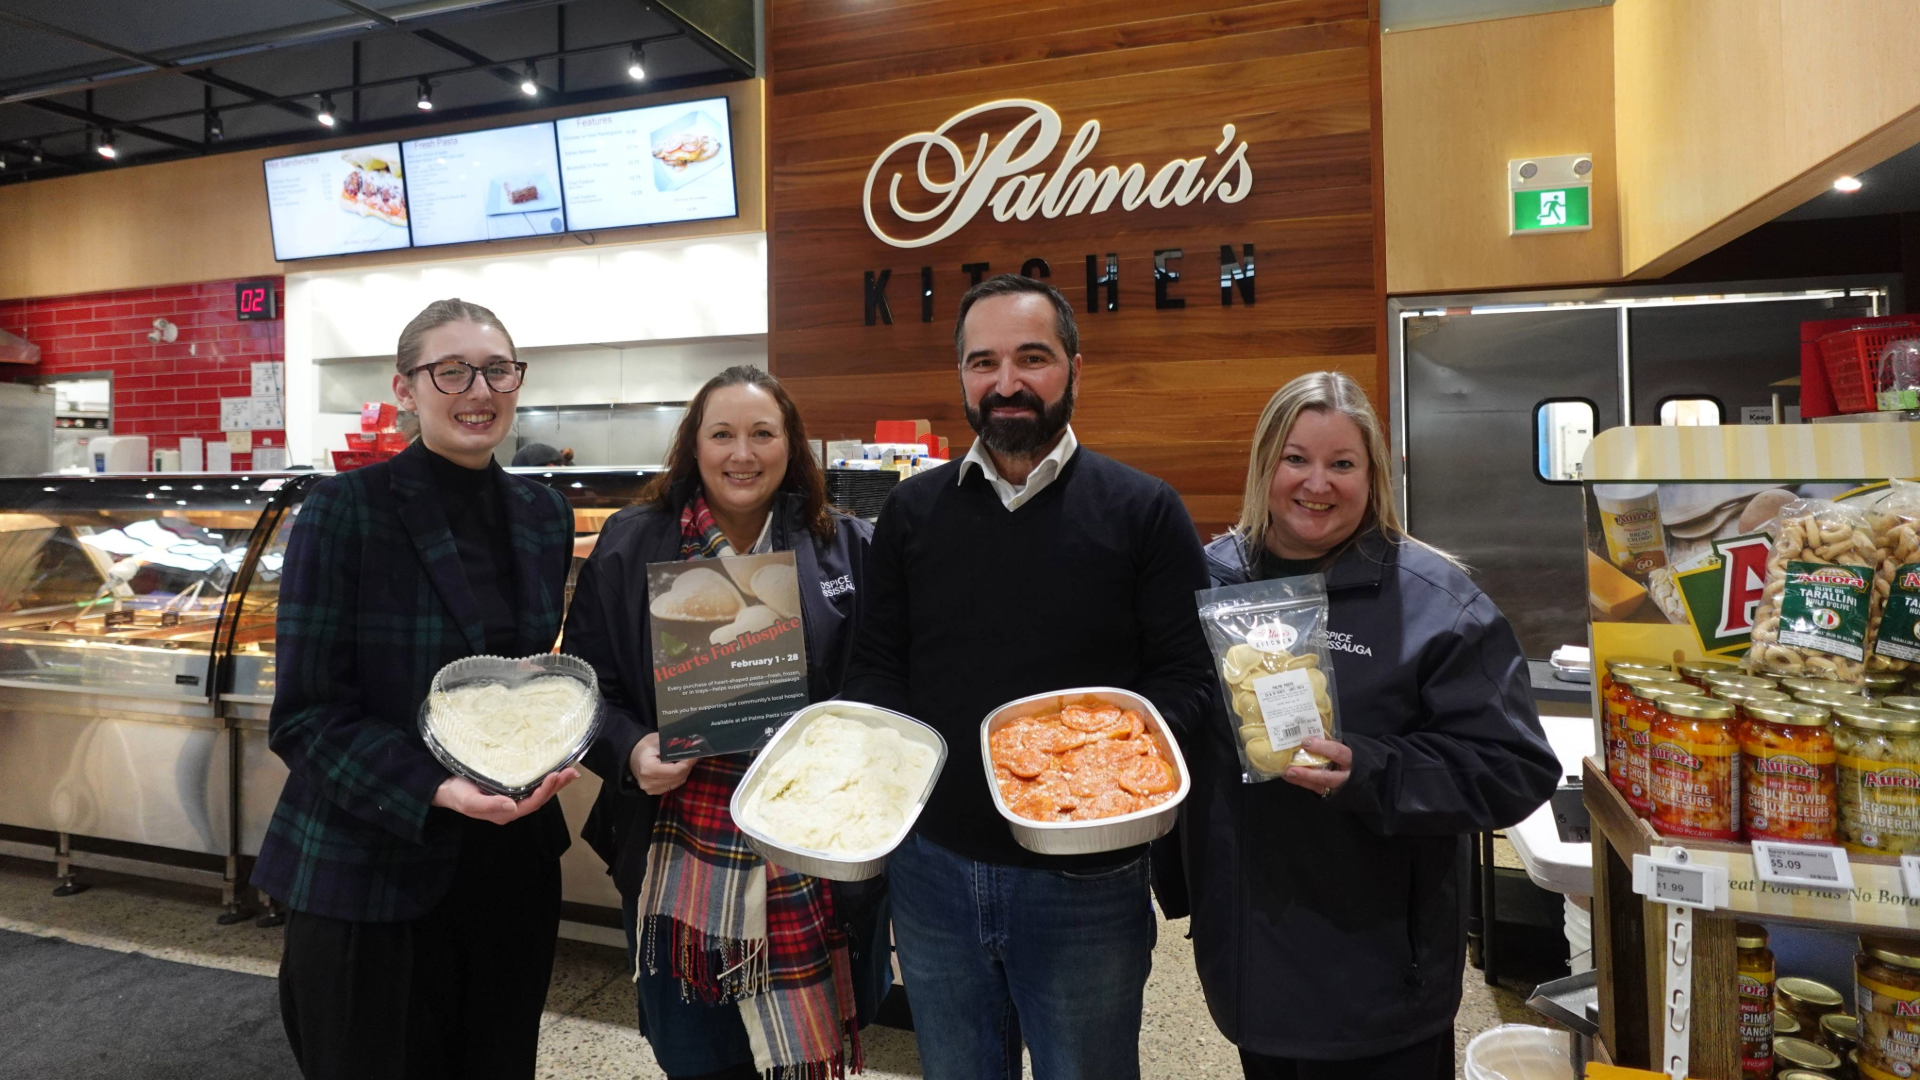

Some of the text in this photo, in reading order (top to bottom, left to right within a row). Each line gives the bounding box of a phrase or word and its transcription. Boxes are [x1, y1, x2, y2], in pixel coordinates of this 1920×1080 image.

[577, 116, 612, 128] Features
[414, 138, 458, 150] Fresh Pasta
[863, 99, 1253, 248] Palma's
[864, 243, 1256, 326] KITHEN
[241, 288, 265, 312] 02
[1749, 414, 1772, 422] Keep
[1616, 511, 1656, 524] Aurora
[1636, 560, 1654, 570] 60
[1799, 574, 1865, 588] Aurora
[1800, 588, 1857, 606] TARALLINI
[1806, 596, 1850, 611] HUILE D'OLIVE
[654, 617, 800, 683] Hearts For Hospice
[730, 657, 774, 668] February
[786, 654, 798, 662] 28
[682, 682, 708, 690] purchase
[714, 676, 748, 685] heart-shaped
[698, 702, 728, 711] supporting
[738, 696, 772, 706] community's
[784, 692, 806, 700] hospice.
[710, 718, 734, 726] Available
[1652, 746, 1700, 770] Aurora
[1757, 758, 1820, 780] Aurora
[1750, 785, 1827, 805] CAULIFLOWER
[1748, 796, 1829, 818] CHOUX-FLEURS
[1681, 818, 1694, 826] 500
[1770, 858, 1802, 870] $5.09
[1657, 882, 1684, 893] $1.99
[1728, 880, 1756, 892] eat
[1848, 886, 1872, 902] No
[1894, 1029, 1918, 1045] MIXED
[1880, 1038, 1916, 1058] MÉLANGE
